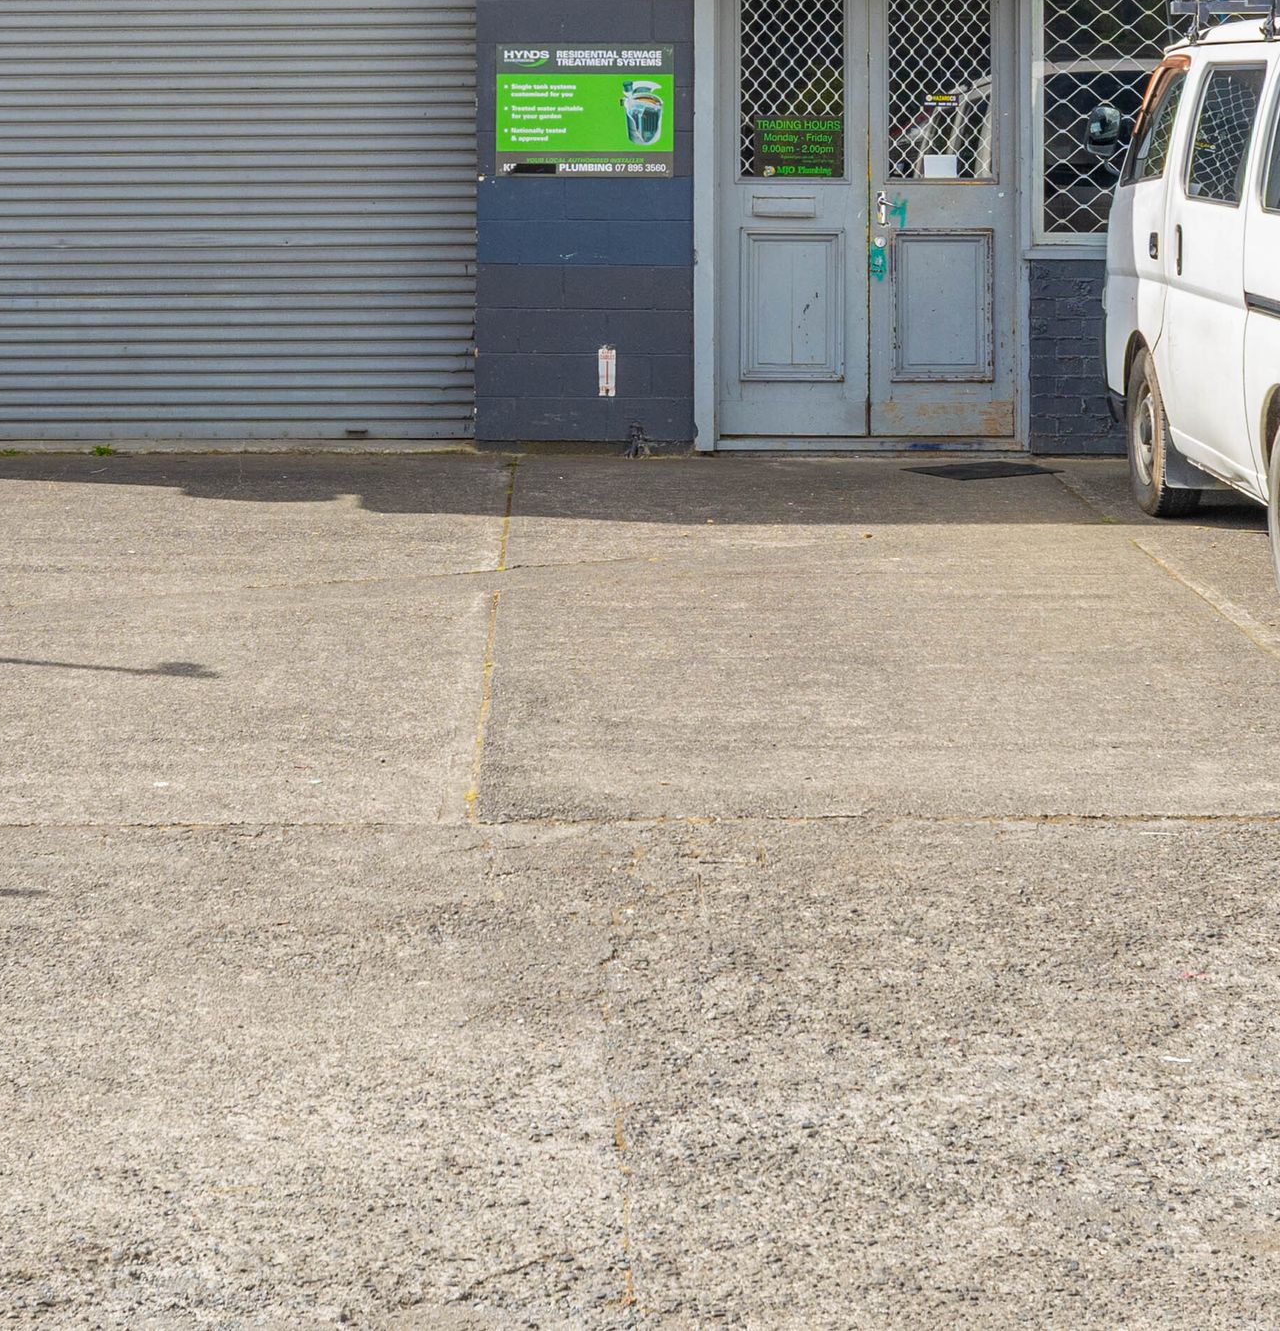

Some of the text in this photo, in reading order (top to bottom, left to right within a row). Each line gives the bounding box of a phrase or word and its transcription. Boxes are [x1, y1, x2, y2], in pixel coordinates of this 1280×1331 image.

[504, 50, 550, 59] HYNDS
[556, 50, 662, 59] RESIDENTIAL SEWAGE
[556, 58, 662, 67] TREATMENT SYSTEMS
[756, 119, 841, 130] TRADING HOURS
[763, 133, 798, 143] Monday
[806, 133, 833, 143] Friday
[762, 144, 794, 153] 9.00am
[801, 144, 834, 154] 2.00pm
[559, 163, 613, 172] PLUMBING
[615, 163, 626, 172] 07
[645, 163, 666, 172] 3560
